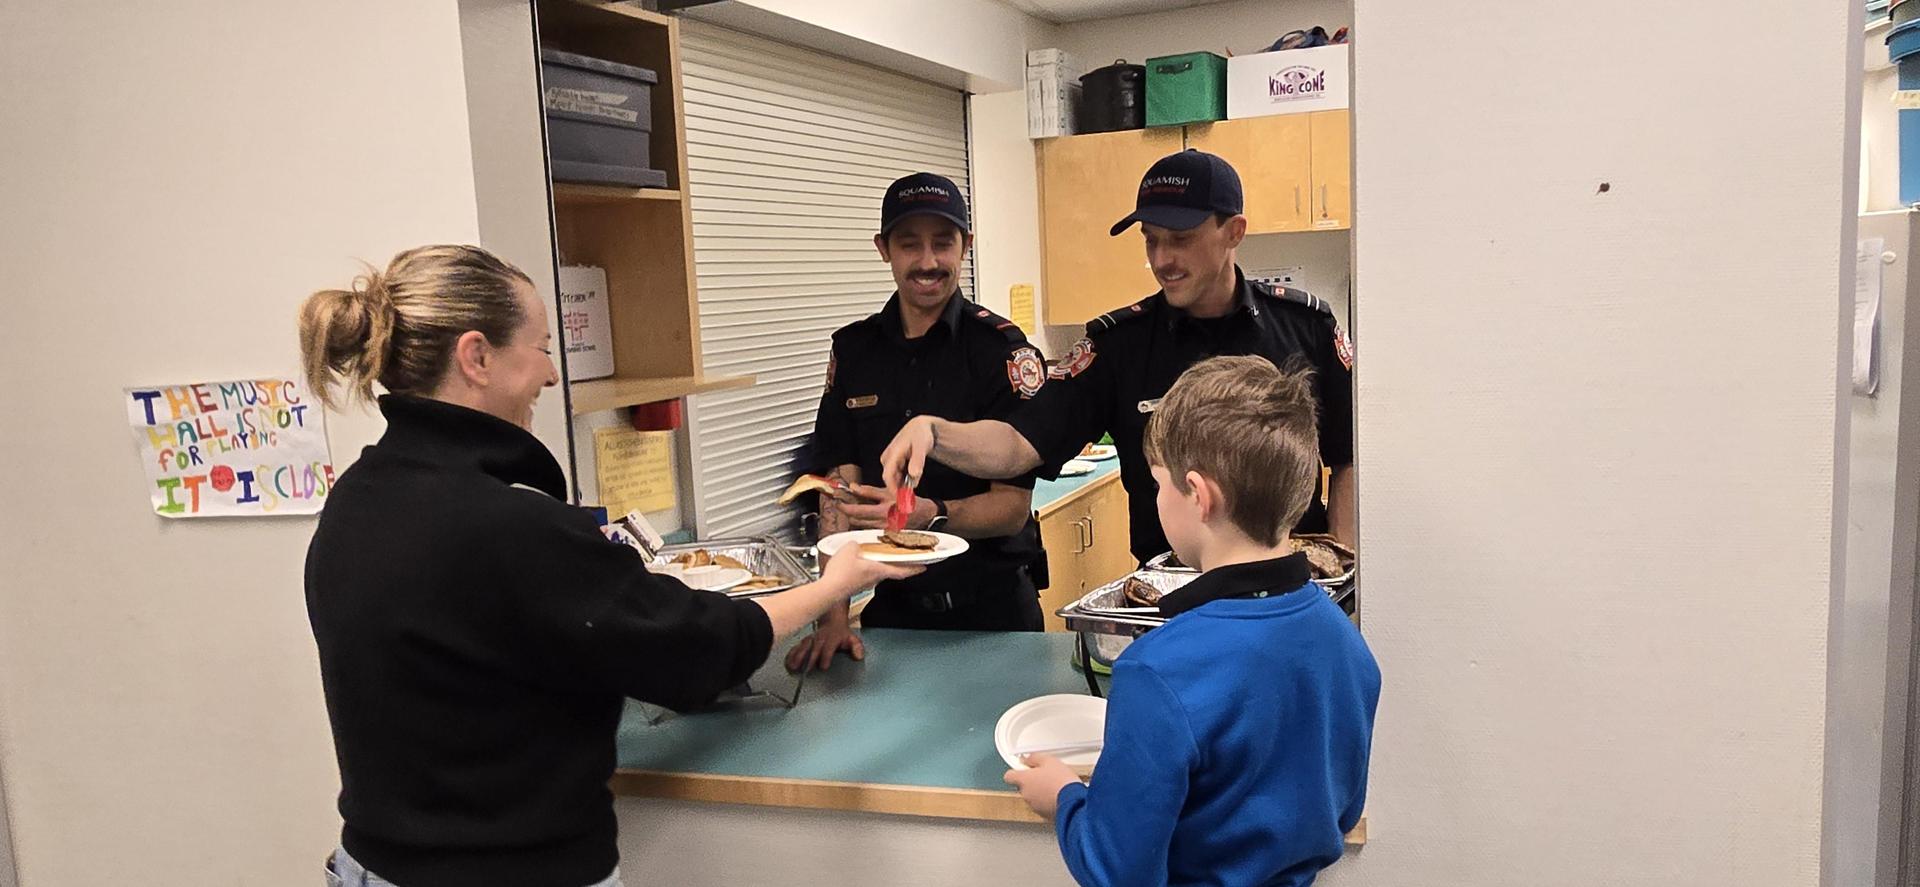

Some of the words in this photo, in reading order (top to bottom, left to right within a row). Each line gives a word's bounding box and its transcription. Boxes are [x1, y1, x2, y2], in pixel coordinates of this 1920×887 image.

[1299, 70, 1325, 93] CONE
[899, 186, 950, 198] SQUAMISH
[132, 384, 218, 425] THE
[219, 380, 300, 410] MUSIC
[146, 415, 228, 449] HALL
[235, 408, 256, 434] IS
[260, 405, 308, 430] NOT
[156, 475, 207, 513] IT
[236, 464, 278, 512] IS
